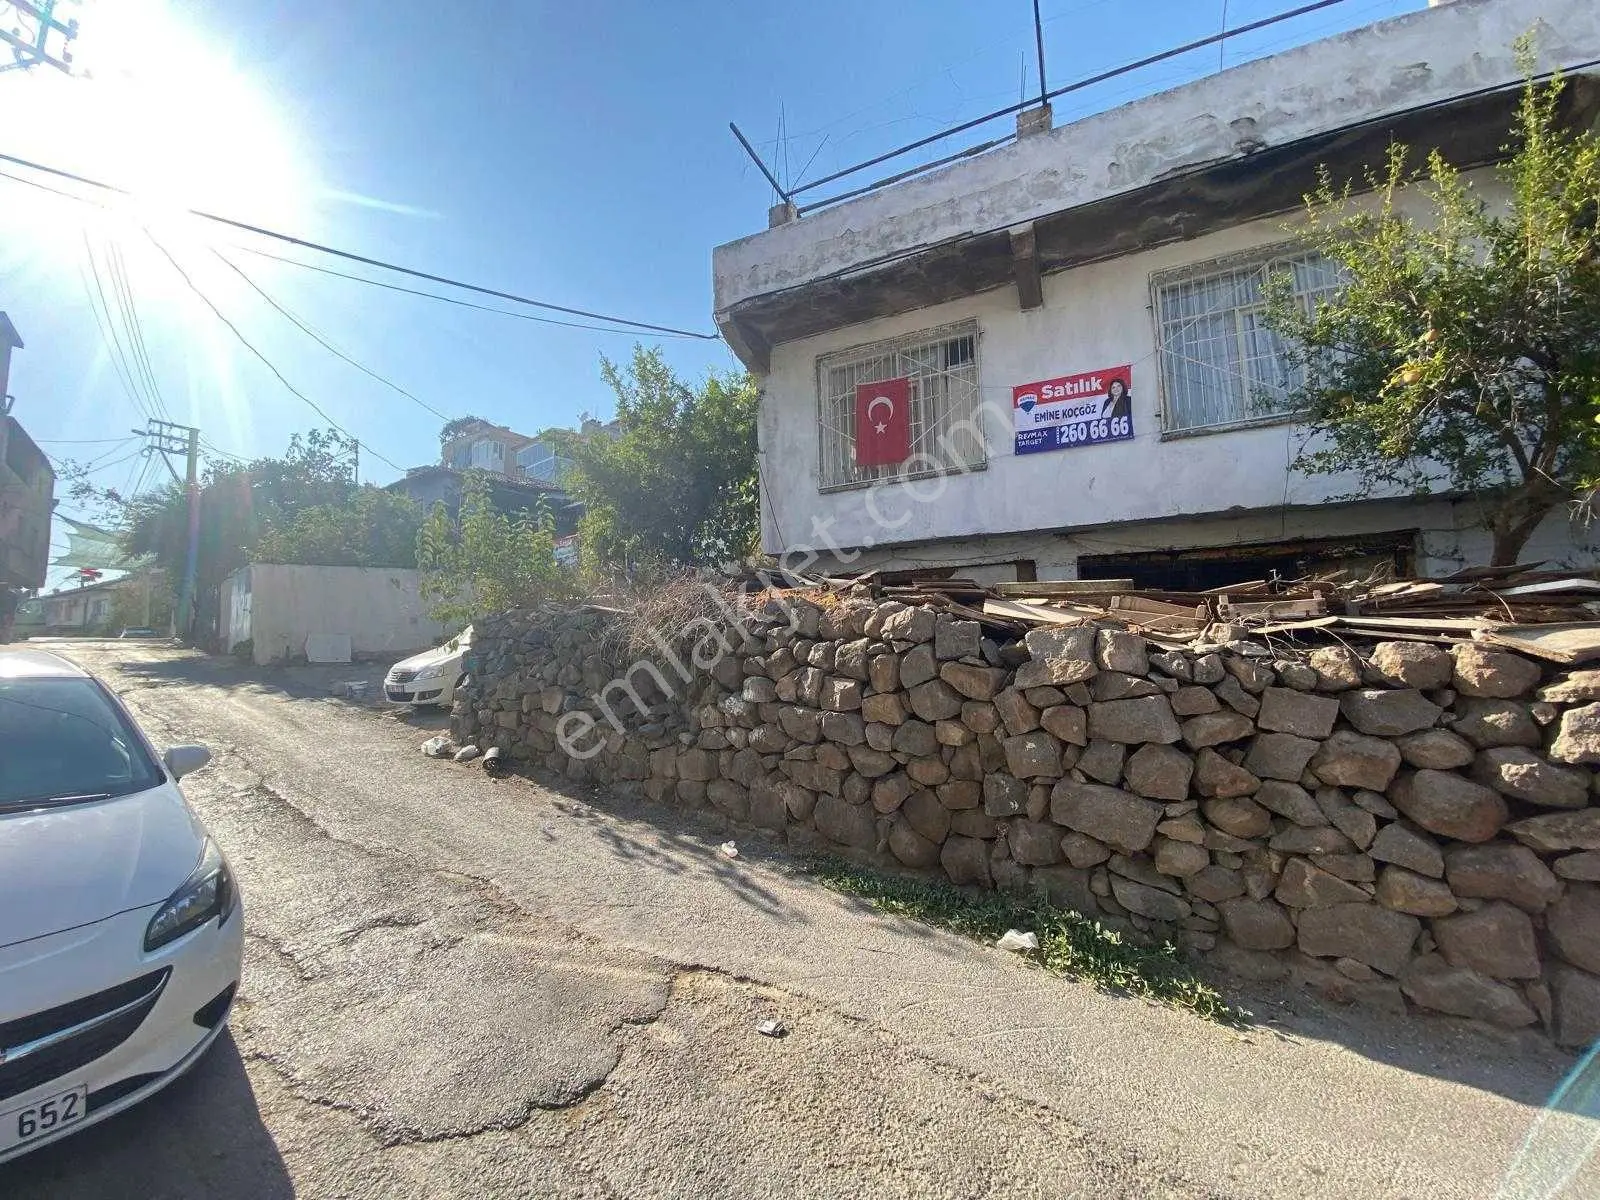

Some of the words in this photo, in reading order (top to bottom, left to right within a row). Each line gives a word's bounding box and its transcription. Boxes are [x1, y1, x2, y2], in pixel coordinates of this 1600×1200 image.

[1041, 377, 1102, 399] Satılık
[1034, 409, 1060, 423] EMİNE
[1060, 422, 1087, 444] 260
[1089, 419, 1109, 439] 66
[1110, 416, 1129, 436] 66
[18, 1092, 79, 1138] 652
